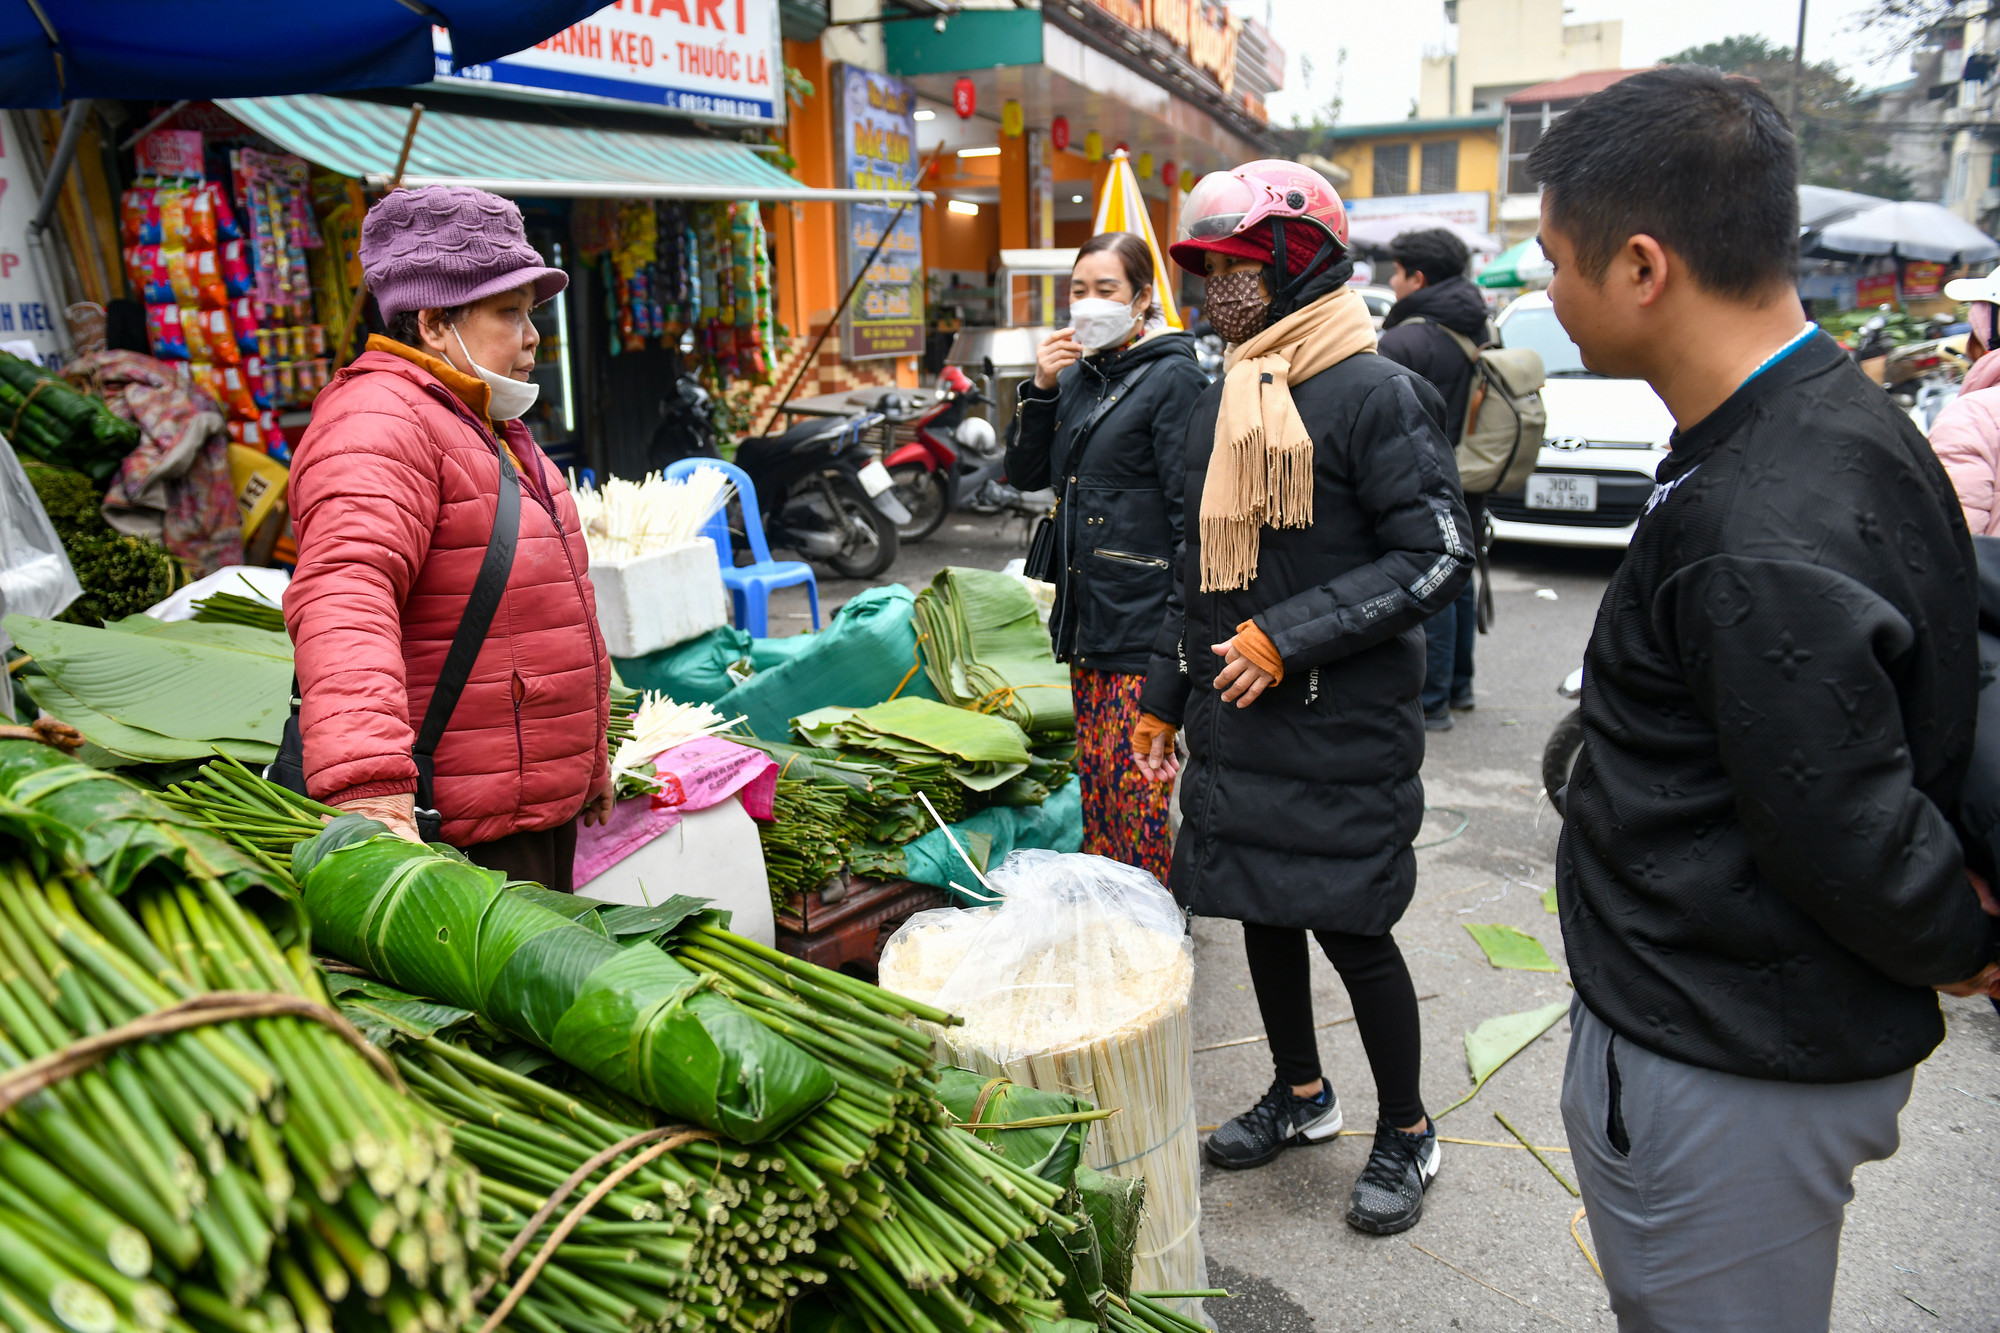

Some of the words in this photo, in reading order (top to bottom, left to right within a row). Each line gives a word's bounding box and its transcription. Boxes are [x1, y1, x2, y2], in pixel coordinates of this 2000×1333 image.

[610, 28, 653, 73] KẸO
[676, 37, 740, 82] THUỐC
[746, 49, 768, 85] LÁ
